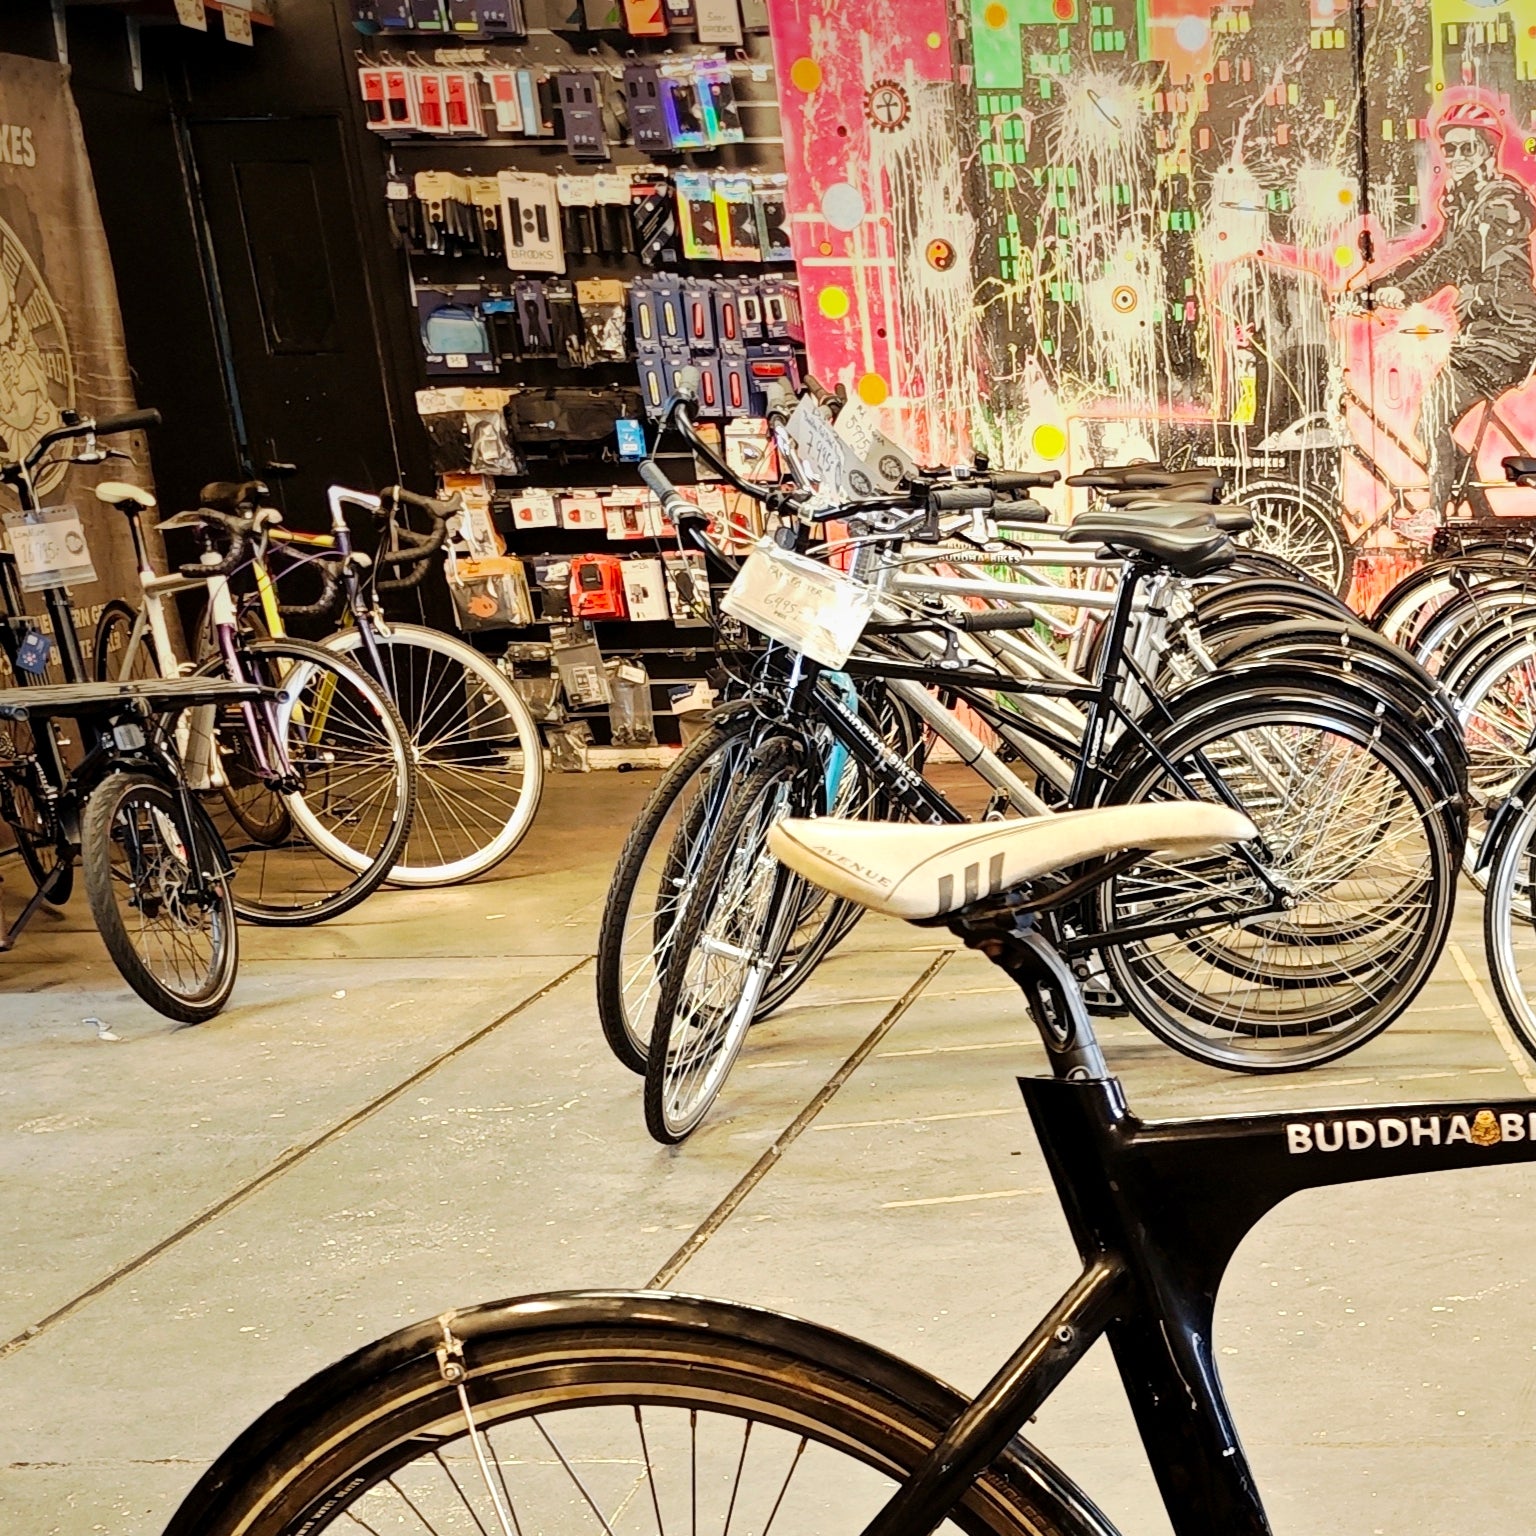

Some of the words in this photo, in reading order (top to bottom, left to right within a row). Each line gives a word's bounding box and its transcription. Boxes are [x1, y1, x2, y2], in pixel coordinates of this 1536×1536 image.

[510, 249, 554, 261] BROOKS
[1196, 455, 1241, 469] BUDDHA
[1252, 456, 1286, 468] BIKES
[837, 703, 887, 752] BUDDHA
[888, 753, 922, 787] BIKES
[813, 846, 892, 888] AVENUE
[1286, 1114, 1472, 1155] BUDDHA
